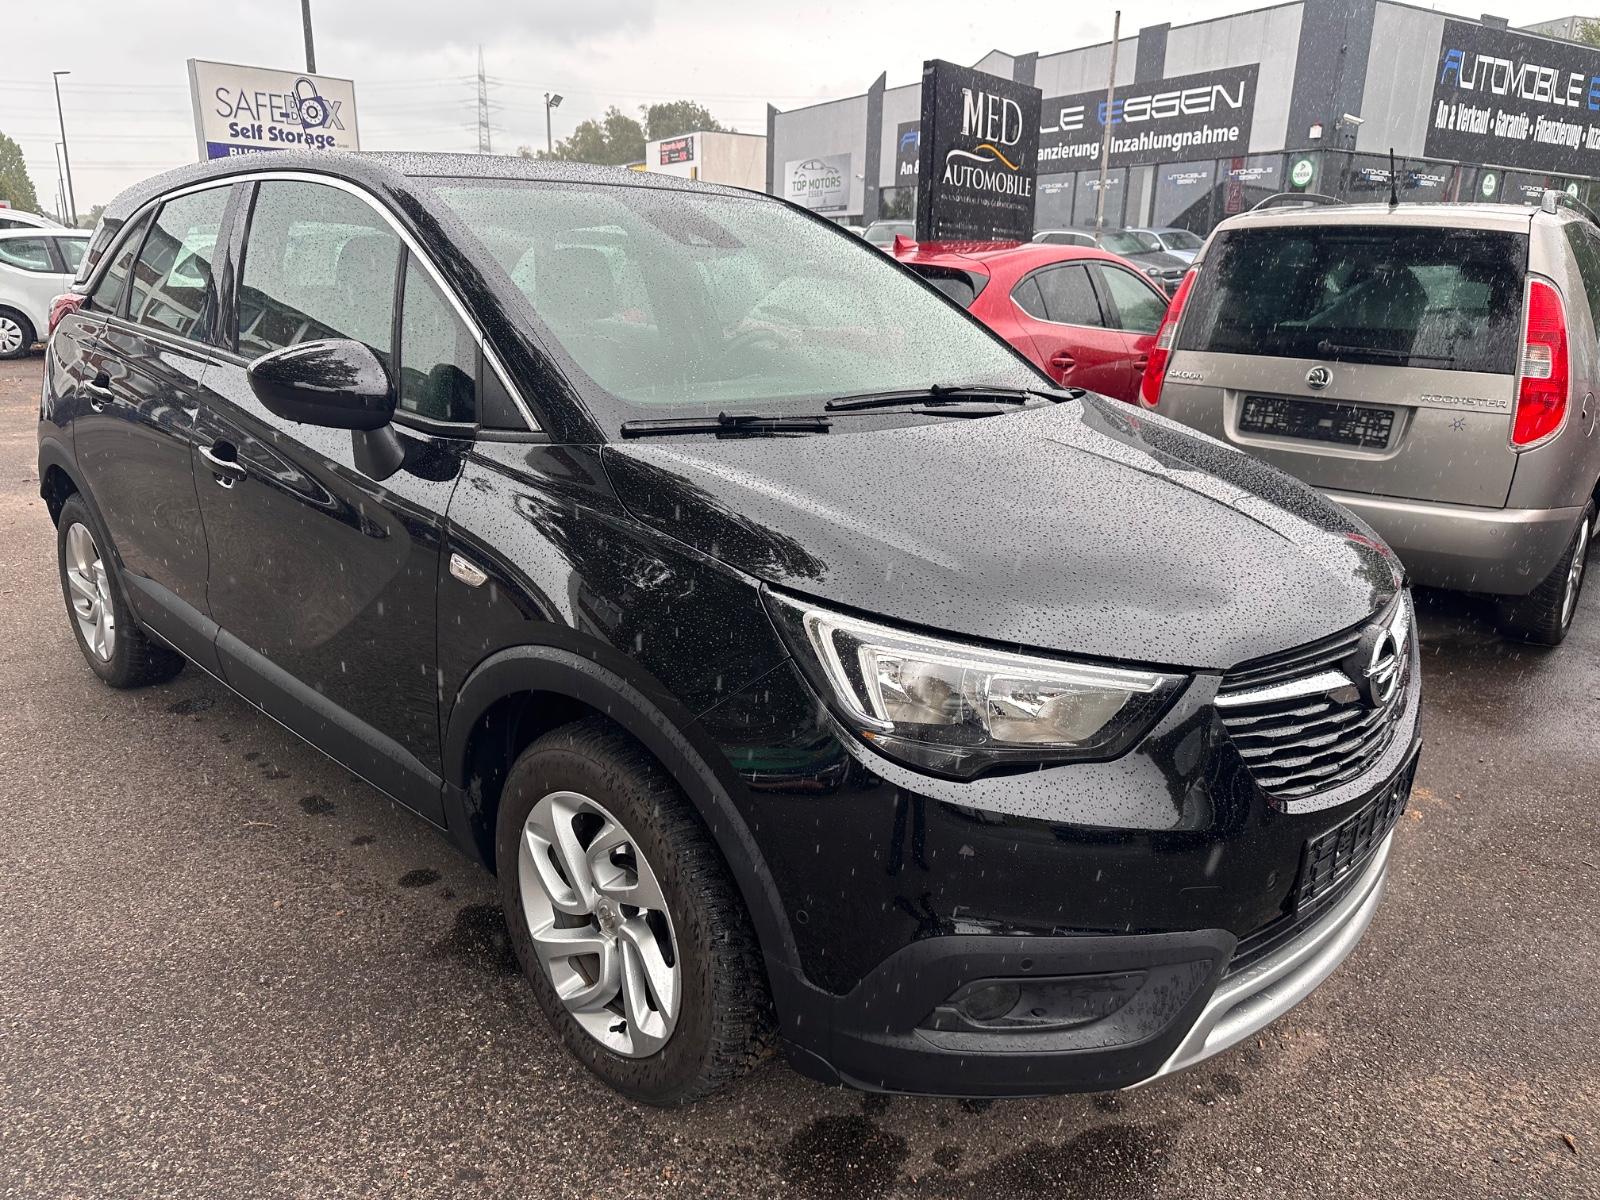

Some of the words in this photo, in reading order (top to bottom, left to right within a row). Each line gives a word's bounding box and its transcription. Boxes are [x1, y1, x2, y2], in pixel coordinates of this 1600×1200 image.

[1440, 49, 1585, 108] AUTOMOBILE
[960, 87, 1023, 146] MED
[1098, 81, 1245, 125] ESSEN
[228, 121, 263, 140] Self
[267, 126, 336, 150] Storage
[1109, 125, 1240, 154] Inzahlungnahme
[1434, 99, 1449, 129] An
[1448, 104, 1457, 130] &
[1456, 102, 1491, 135] Verkauf
[1494, 109, 1530, 140] Garantie
[1533, 114, 1583, 151] Finanzierung
[900, 160, 913, 175] An
[942, 163, 1032, 197] AUTOMOBILE
[1166, 171, 1208, 180] UTOMOBILE
[792, 180, 807, 191] TOP
[808, 175, 842, 190] MOTORS
[1420, 394, 1507, 408] ROOMSTER
